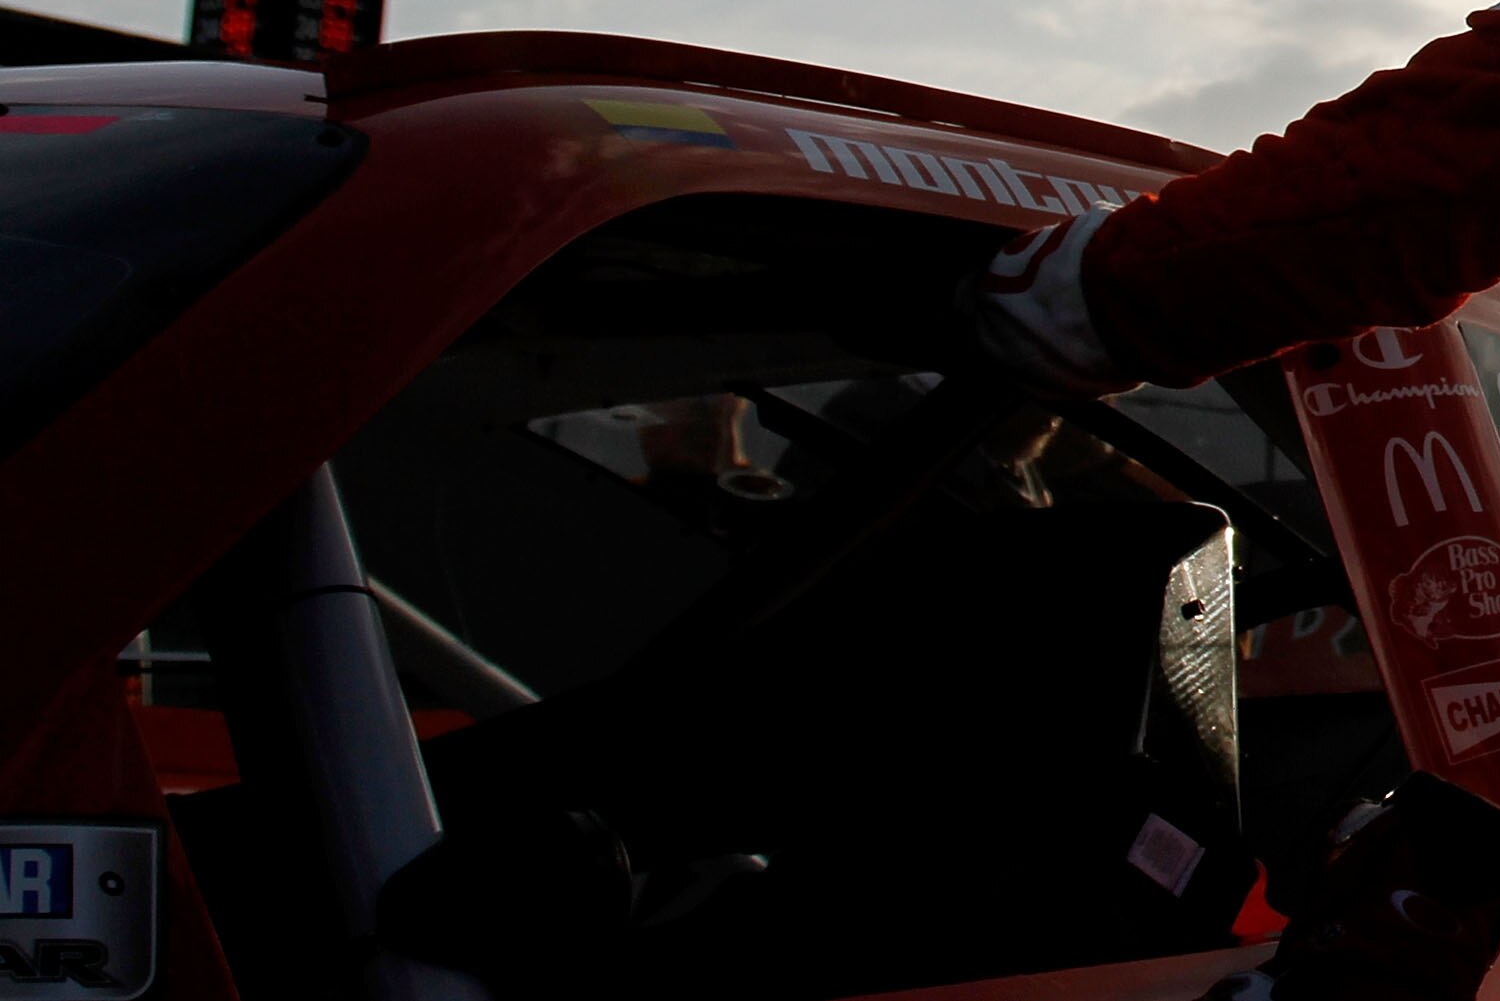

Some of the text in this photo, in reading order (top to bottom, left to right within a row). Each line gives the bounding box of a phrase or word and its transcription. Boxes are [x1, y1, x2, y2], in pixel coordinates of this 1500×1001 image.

[785, 128, 1141, 216] monto
[1303, 376, 1481, 416] Champion
[1447, 543, 1500, 571] Bass
[1460, 568, 1497, 594] Pro
